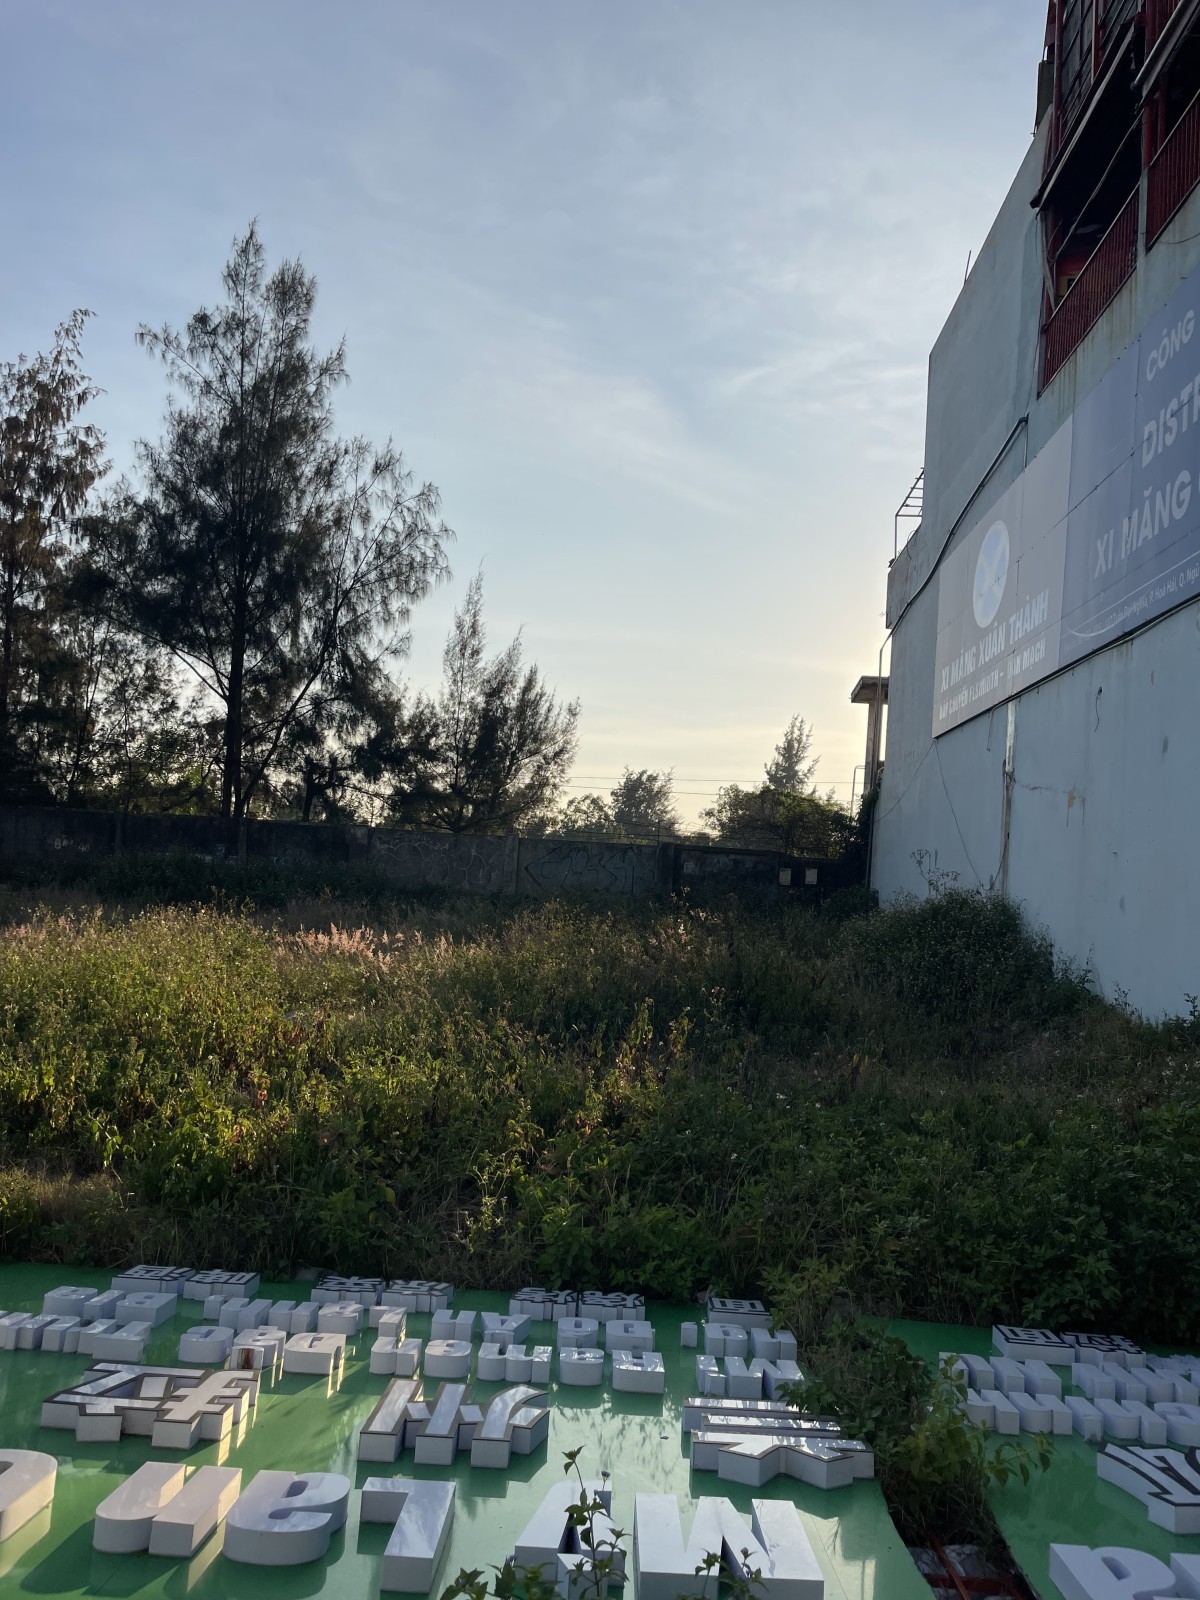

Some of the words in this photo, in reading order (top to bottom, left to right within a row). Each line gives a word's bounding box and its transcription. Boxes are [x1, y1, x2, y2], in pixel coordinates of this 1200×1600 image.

[1094, 528, 1115, 580] XI
[1121, 470, 1192, 561] MĂNG
[941, 665, 950, 693] XI
[950, 645, 977, 687] MĂNG
[978, 620, 1006, 668] XUÂN
[1009, 589, 1049, 645] THÀNH
[1023, 637, 1046, 671] MẠCH
[111, 1265, 260, 1295] 啤酒
[370, 1337, 665, 1389] Ramen
[93, 1461, 457, 1588] Lan
